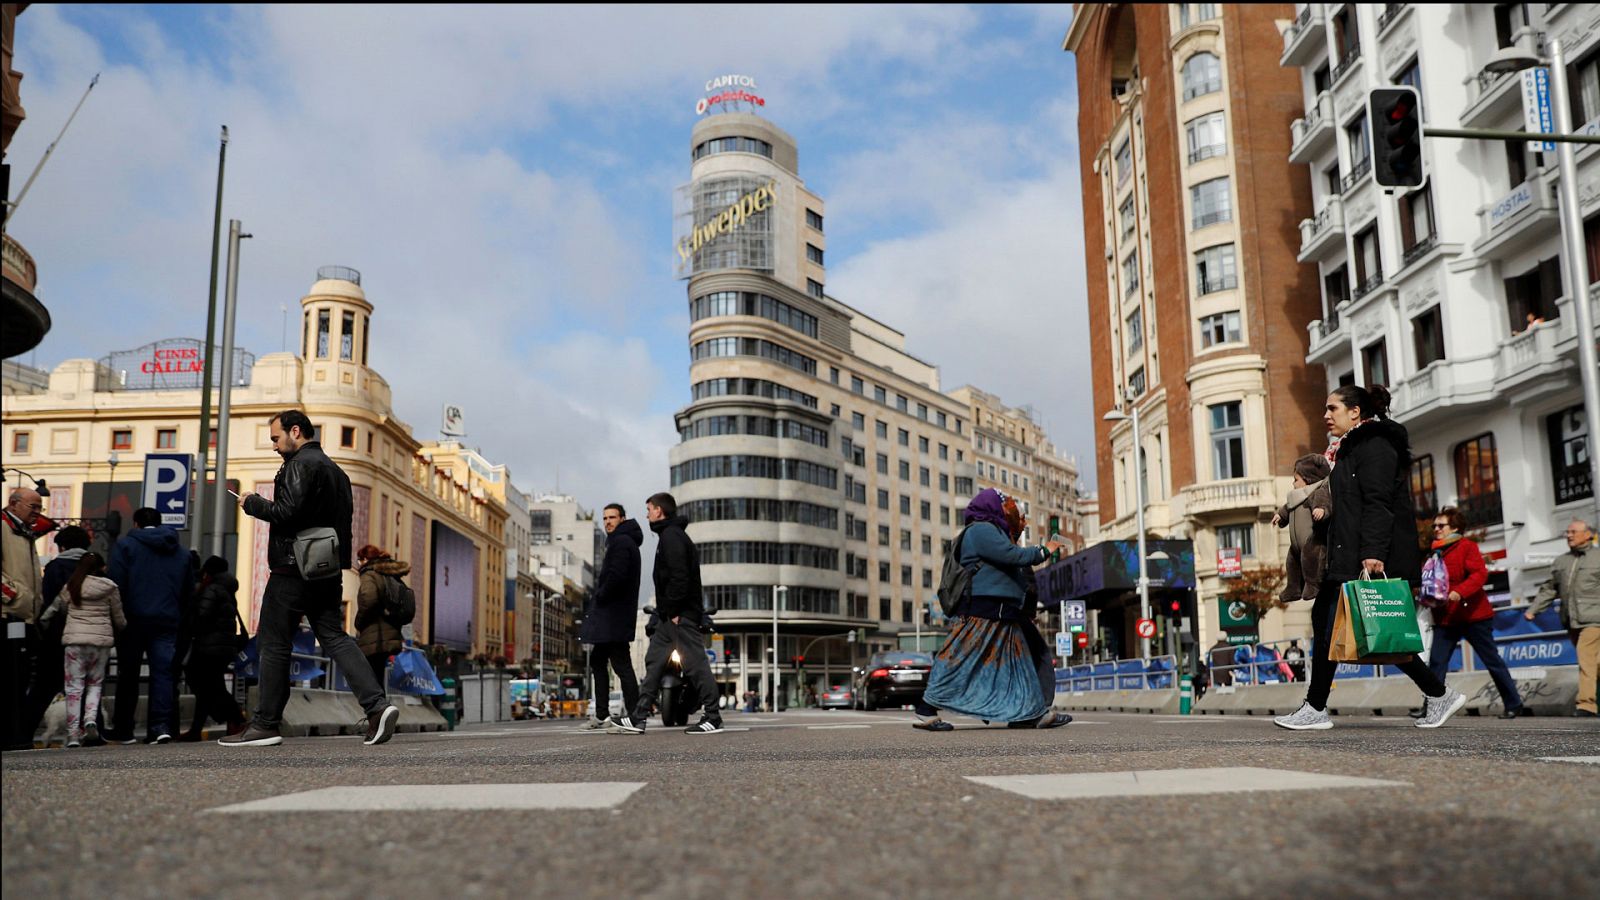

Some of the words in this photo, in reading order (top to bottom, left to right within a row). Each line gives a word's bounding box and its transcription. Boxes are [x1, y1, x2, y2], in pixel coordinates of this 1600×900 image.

[705, 75, 757, 92] CAPITOL
[707, 90, 765, 106] vodafone
[1525, 72, 1536, 124] HOSTAL
[1537, 70, 1553, 149] CONTINENTL
[1491, 189, 1530, 217] HOSTAL
[677, 179, 778, 272] Schweppes
[155, 349, 197, 360] CINES
[144, 459, 187, 510] P
[1561, 483, 1592, 499] BARA
[1050, 563, 1073, 599] CLUB
[1509, 643, 1562, 661] MADRID
[1335, 663, 1360, 673] ADRID
